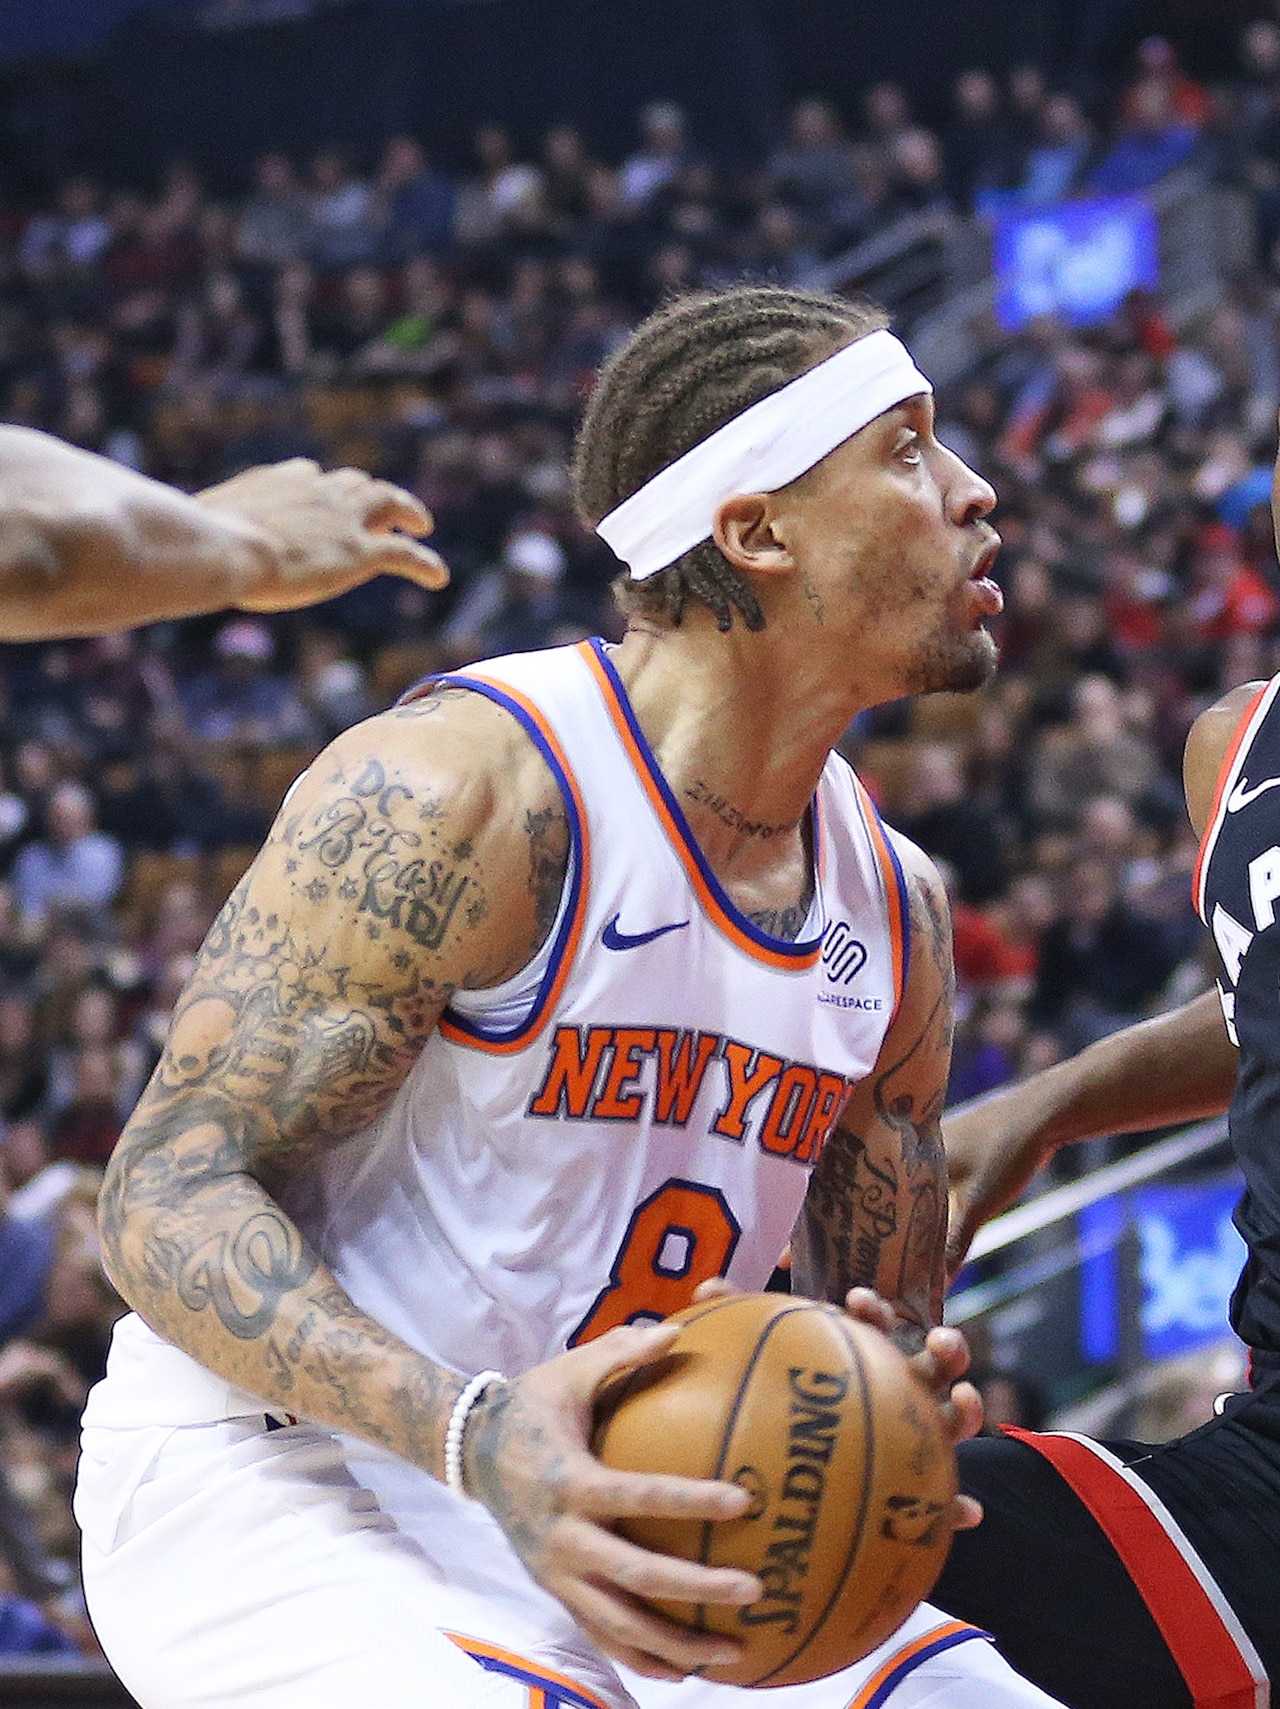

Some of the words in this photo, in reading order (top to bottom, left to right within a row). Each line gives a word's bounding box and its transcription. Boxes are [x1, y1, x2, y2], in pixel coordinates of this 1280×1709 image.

[525, 1023, 720, 1129] NEW
[708, 1040, 854, 1167] YOR
[566, 1176, 743, 1351] 8
[737, 1364, 848, 1635] SPALDING
